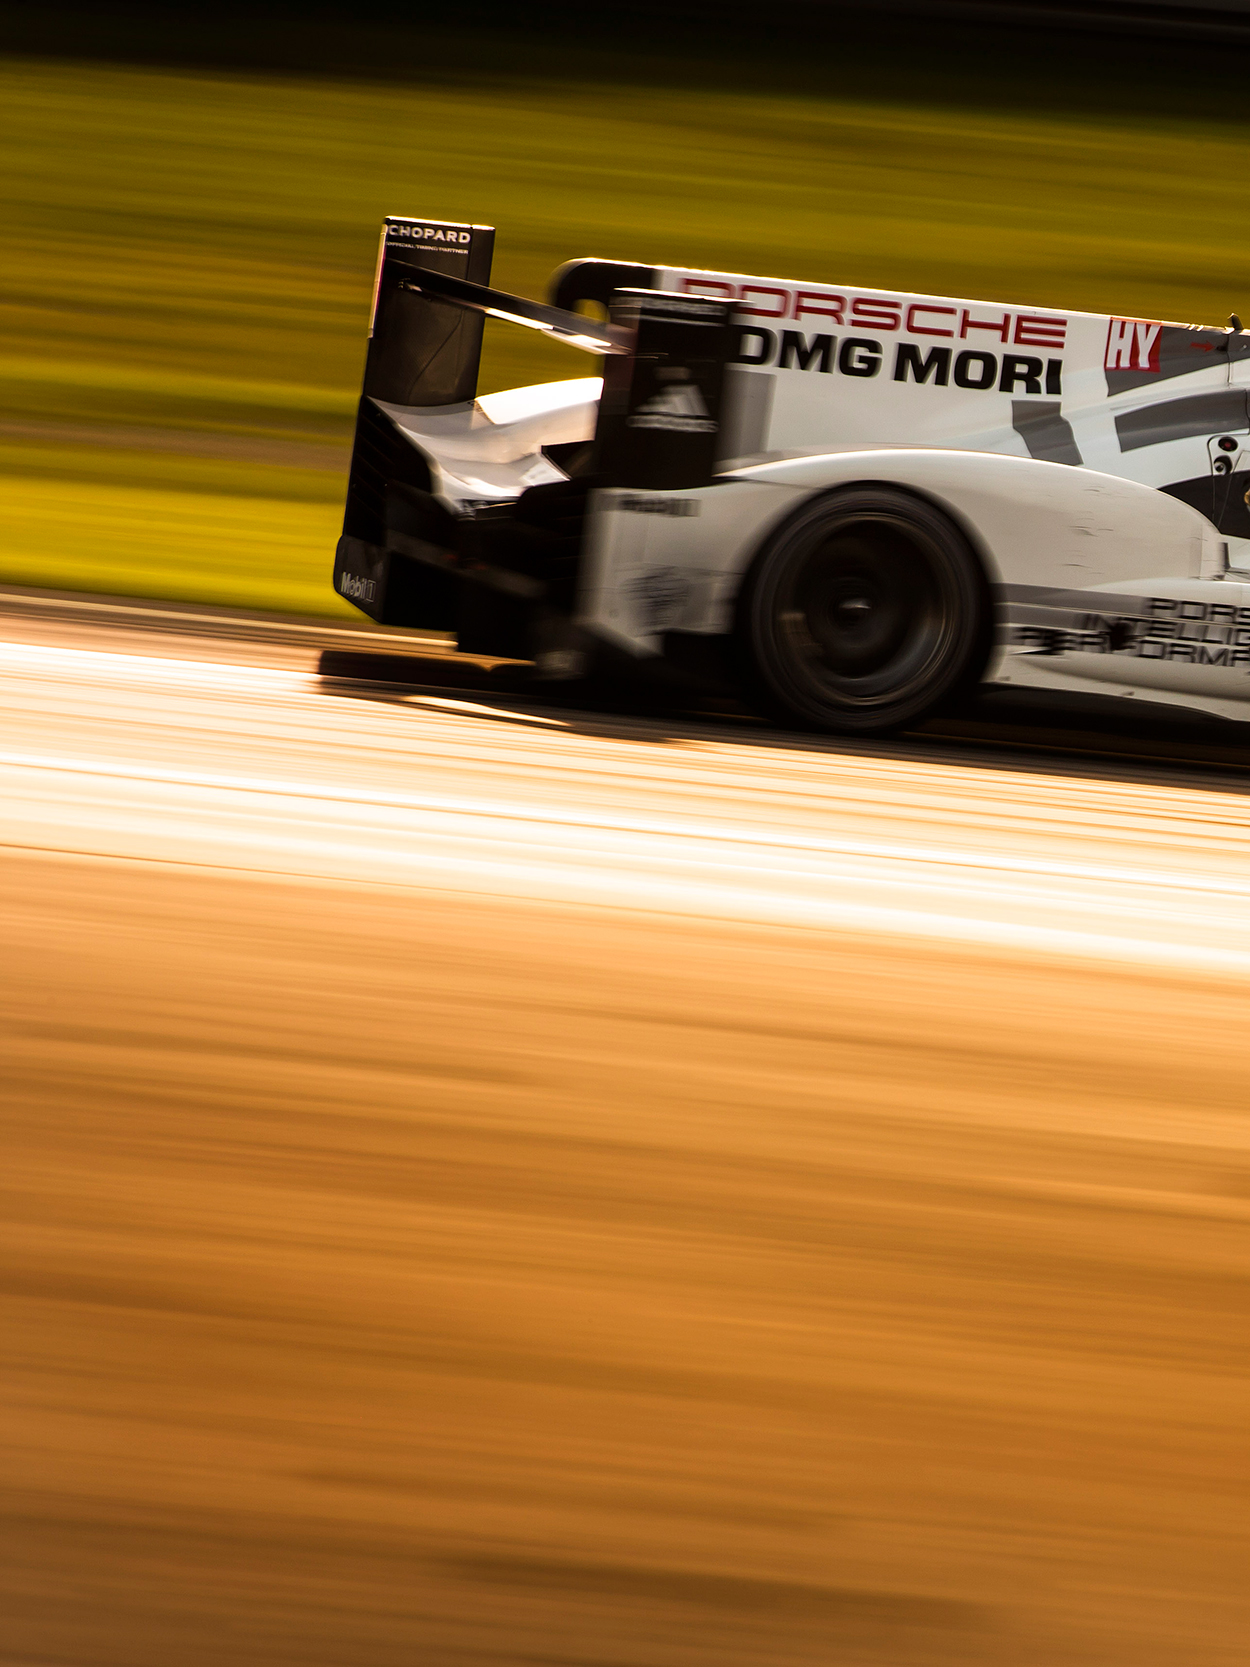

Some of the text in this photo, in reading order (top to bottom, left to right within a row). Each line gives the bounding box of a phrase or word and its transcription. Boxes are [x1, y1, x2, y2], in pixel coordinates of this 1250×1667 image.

[388, 224, 471, 244] CHOPARD
[416, 244, 438, 252] TIMING
[439, 247, 469, 255] PARTNER
[1106, 320, 1160, 368] HY
[738, 325, 1062, 395] DMG MORI
[341, 571, 366, 599] Mobil
